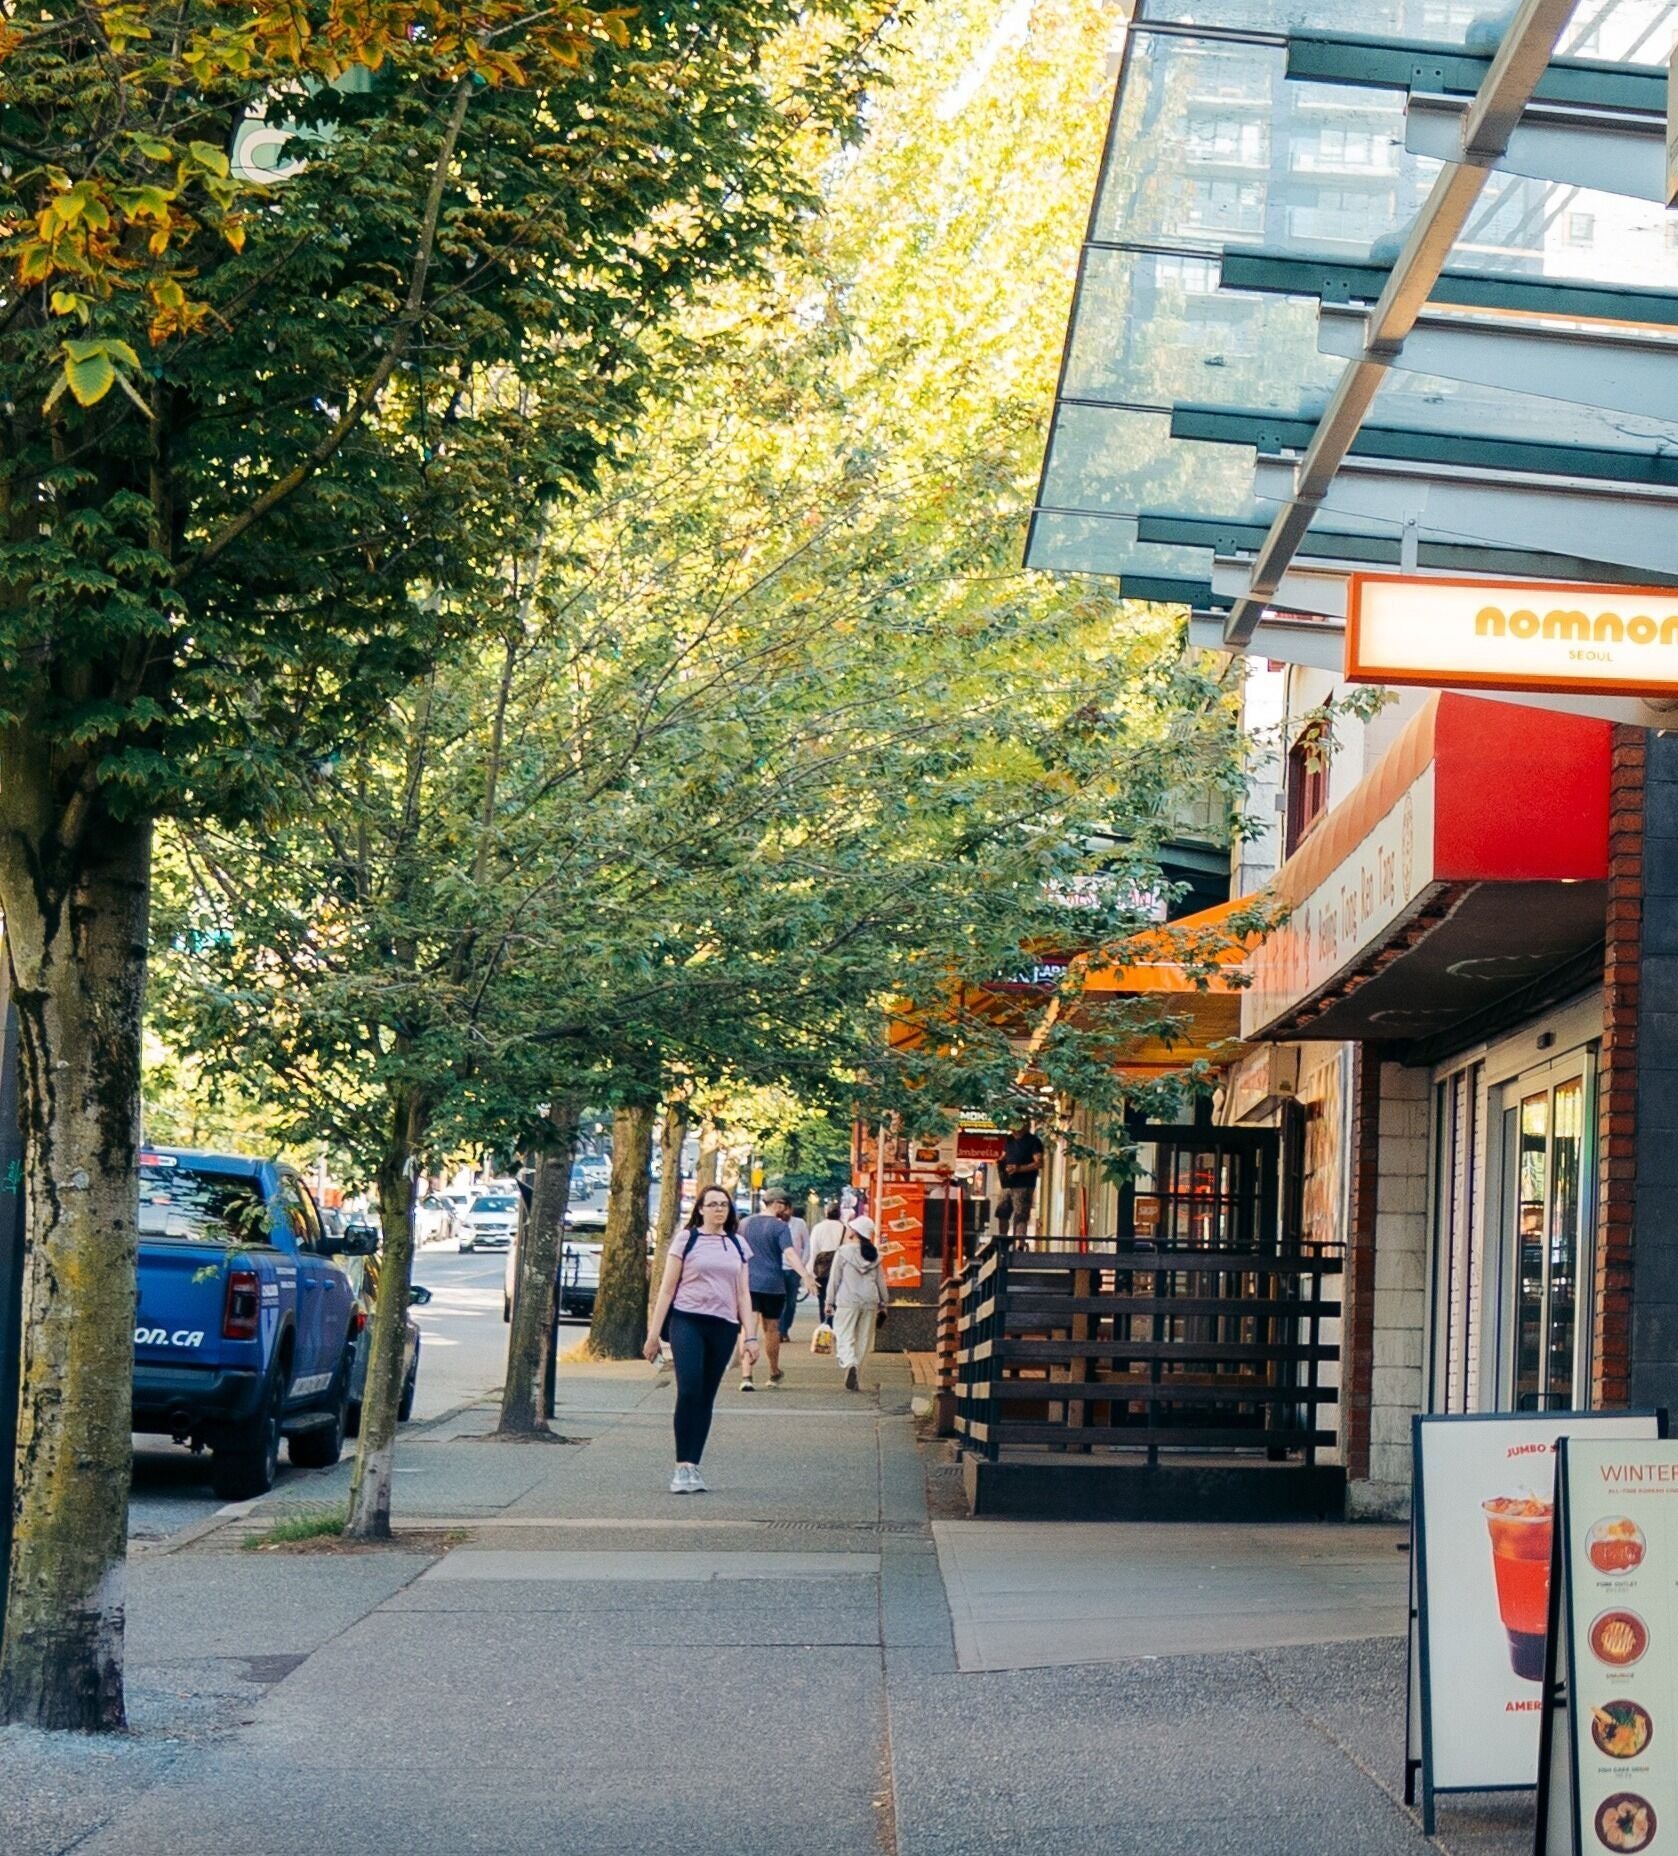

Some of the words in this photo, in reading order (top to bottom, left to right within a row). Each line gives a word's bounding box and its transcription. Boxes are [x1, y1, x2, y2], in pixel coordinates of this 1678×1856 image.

[1568, 649, 1614, 663] SEOUL
[1341, 885, 1358, 943] Tong
[1360, 866, 1374, 924] Ren
[1378, 846, 1396, 907] Tang
[1507, 1443, 1546, 1458] JUMBO
